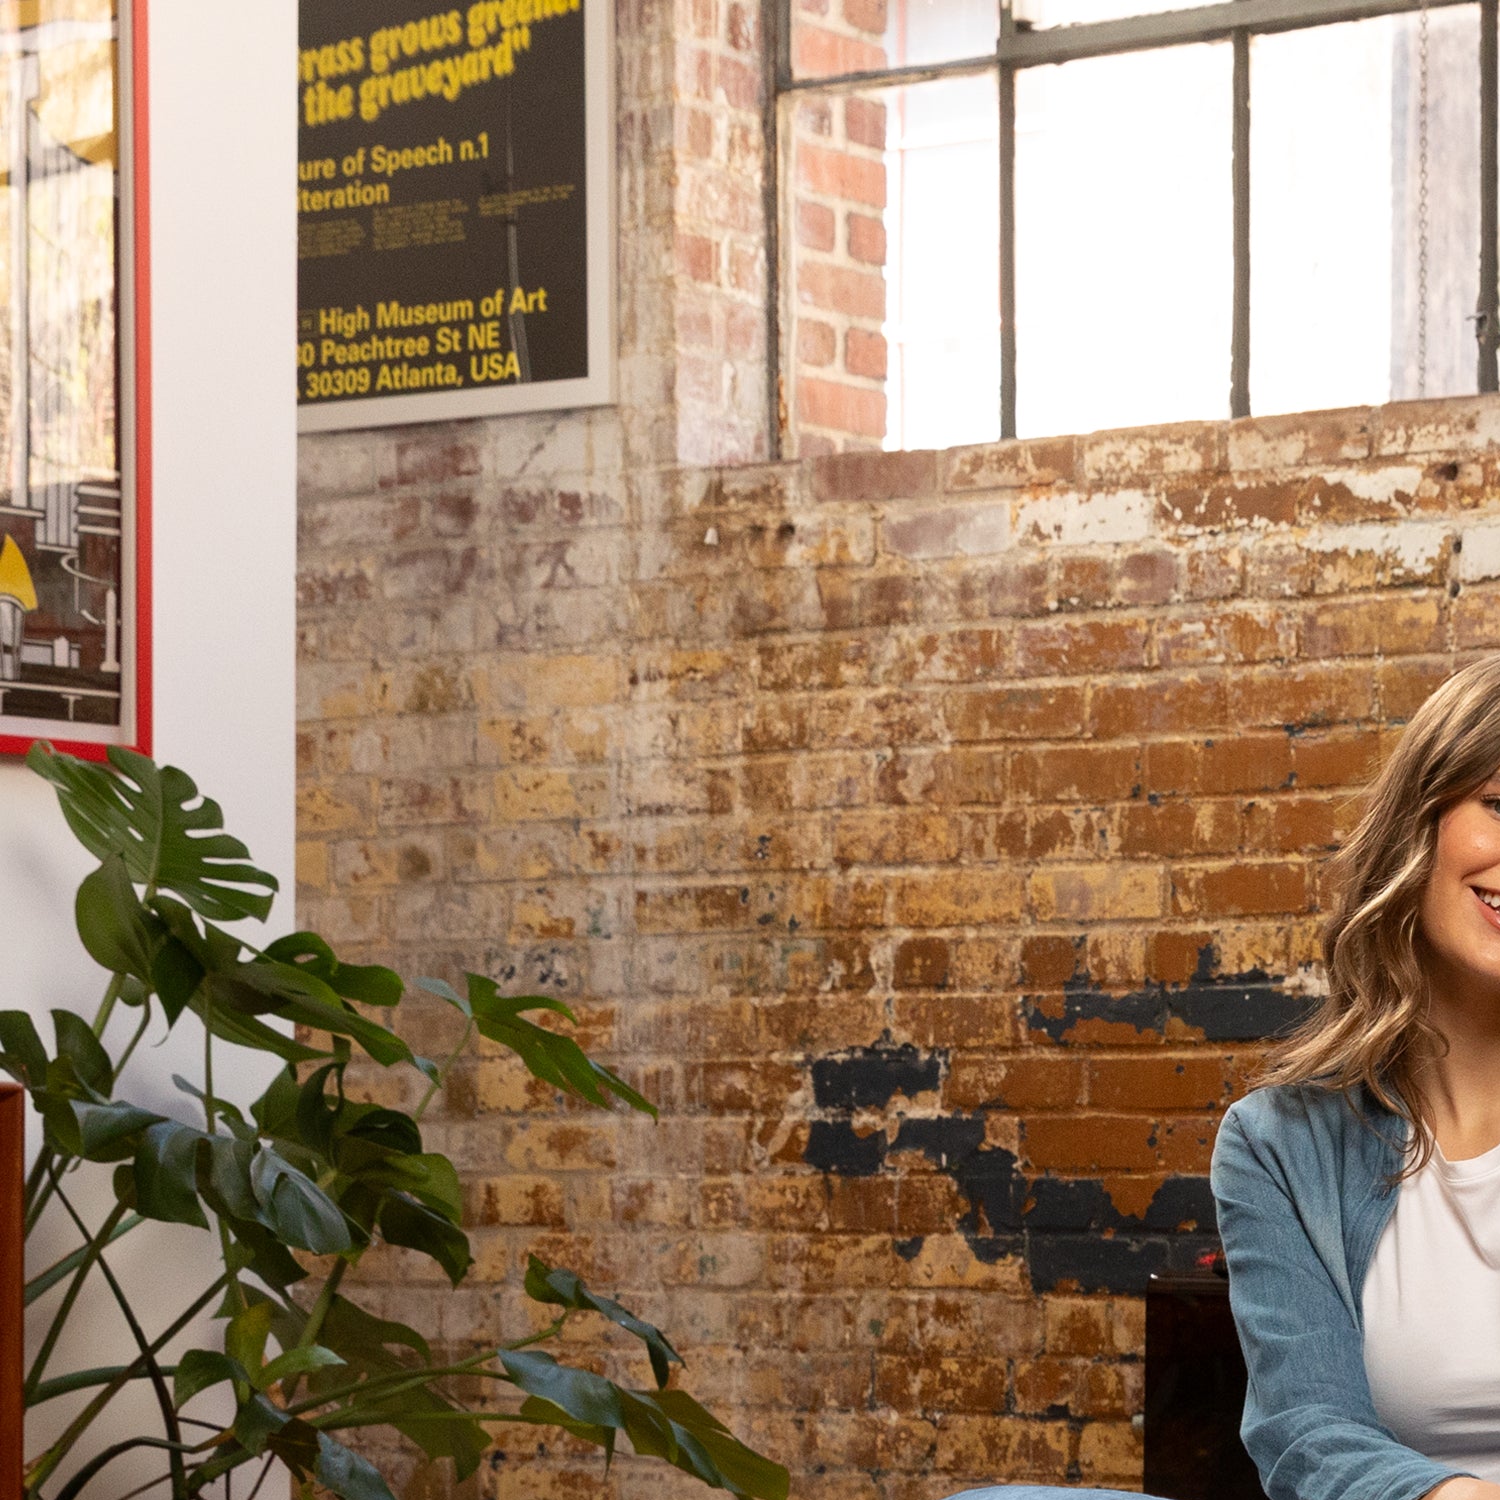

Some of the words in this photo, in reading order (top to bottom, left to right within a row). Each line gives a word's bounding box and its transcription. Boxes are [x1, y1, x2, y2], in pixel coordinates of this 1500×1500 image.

[298, 37, 364, 82] rass
[369, 10, 462, 74] grows
[304, 81, 354, 126] the
[342, 147, 366, 176] of
[371, 136, 453, 177] Speech
[459, 131, 489, 162] n.1
[319, 304, 371, 338] High
[376, 301, 474, 328] Museum
[480, 289, 504, 318] of
[509, 287, 548, 314] Art
[297, 341, 315, 368] 0
[321, 334, 430, 366] Peachtree
[436, 326, 461, 353] St
[467, 321, 500, 350] NE
[306, 367, 371, 398] 30309
[375, 363, 464, 391] Atlanta,
[470, 352, 521, 382] USA
